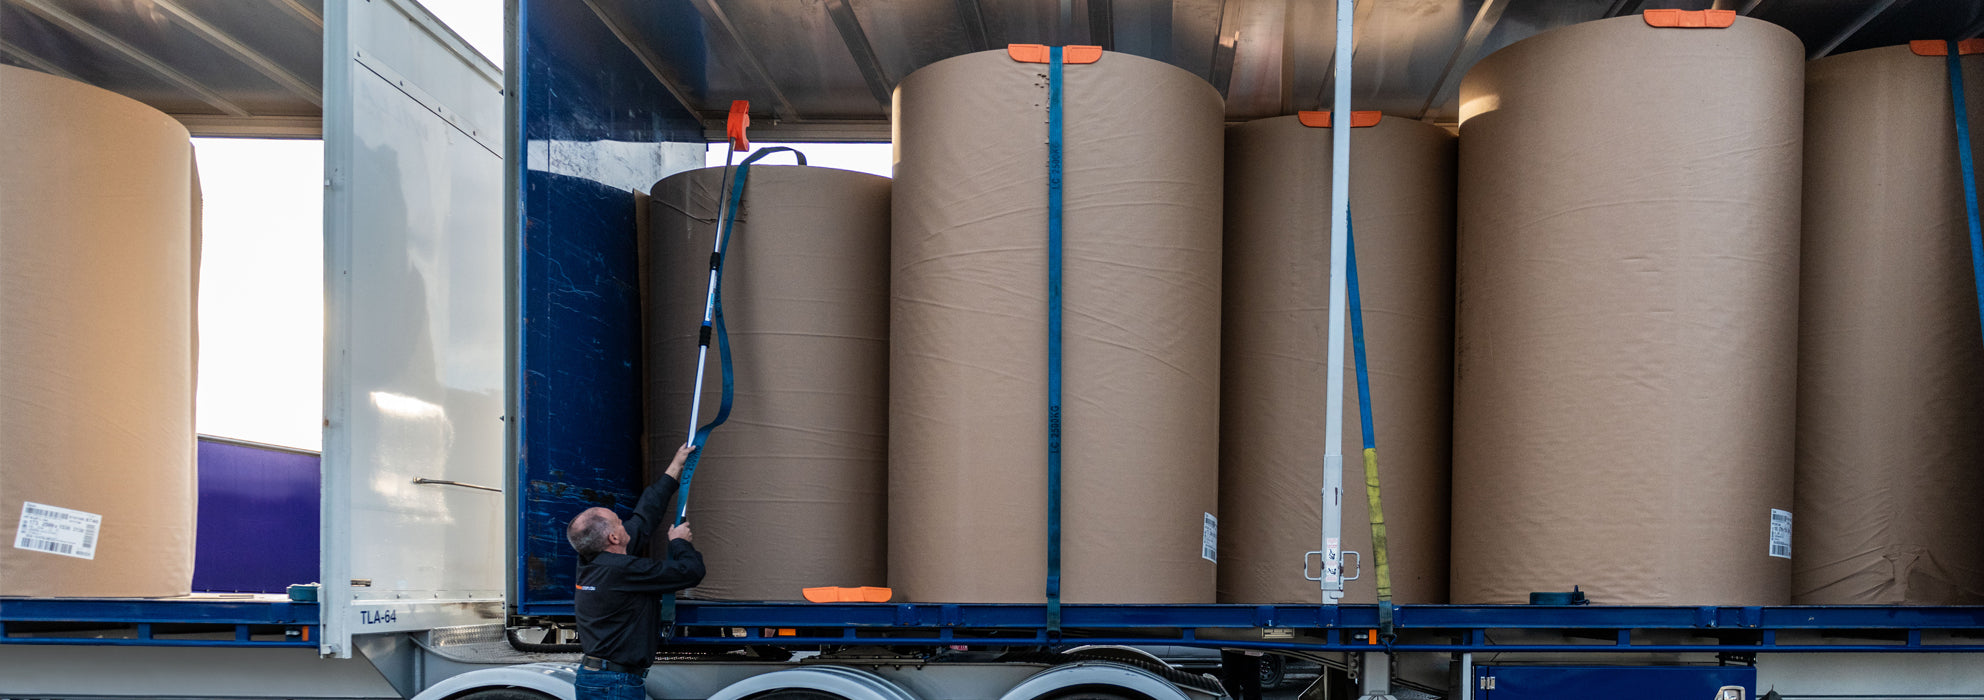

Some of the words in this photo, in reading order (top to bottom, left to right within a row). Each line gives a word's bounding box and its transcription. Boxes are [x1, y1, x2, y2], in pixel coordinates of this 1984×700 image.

[1051, 178, 1061, 189] LC
[1050, 405, 1060, 438] 2500KG
[1050, 441, 1060, 454] LC
[360, 610, 397, 624] TLA-64
